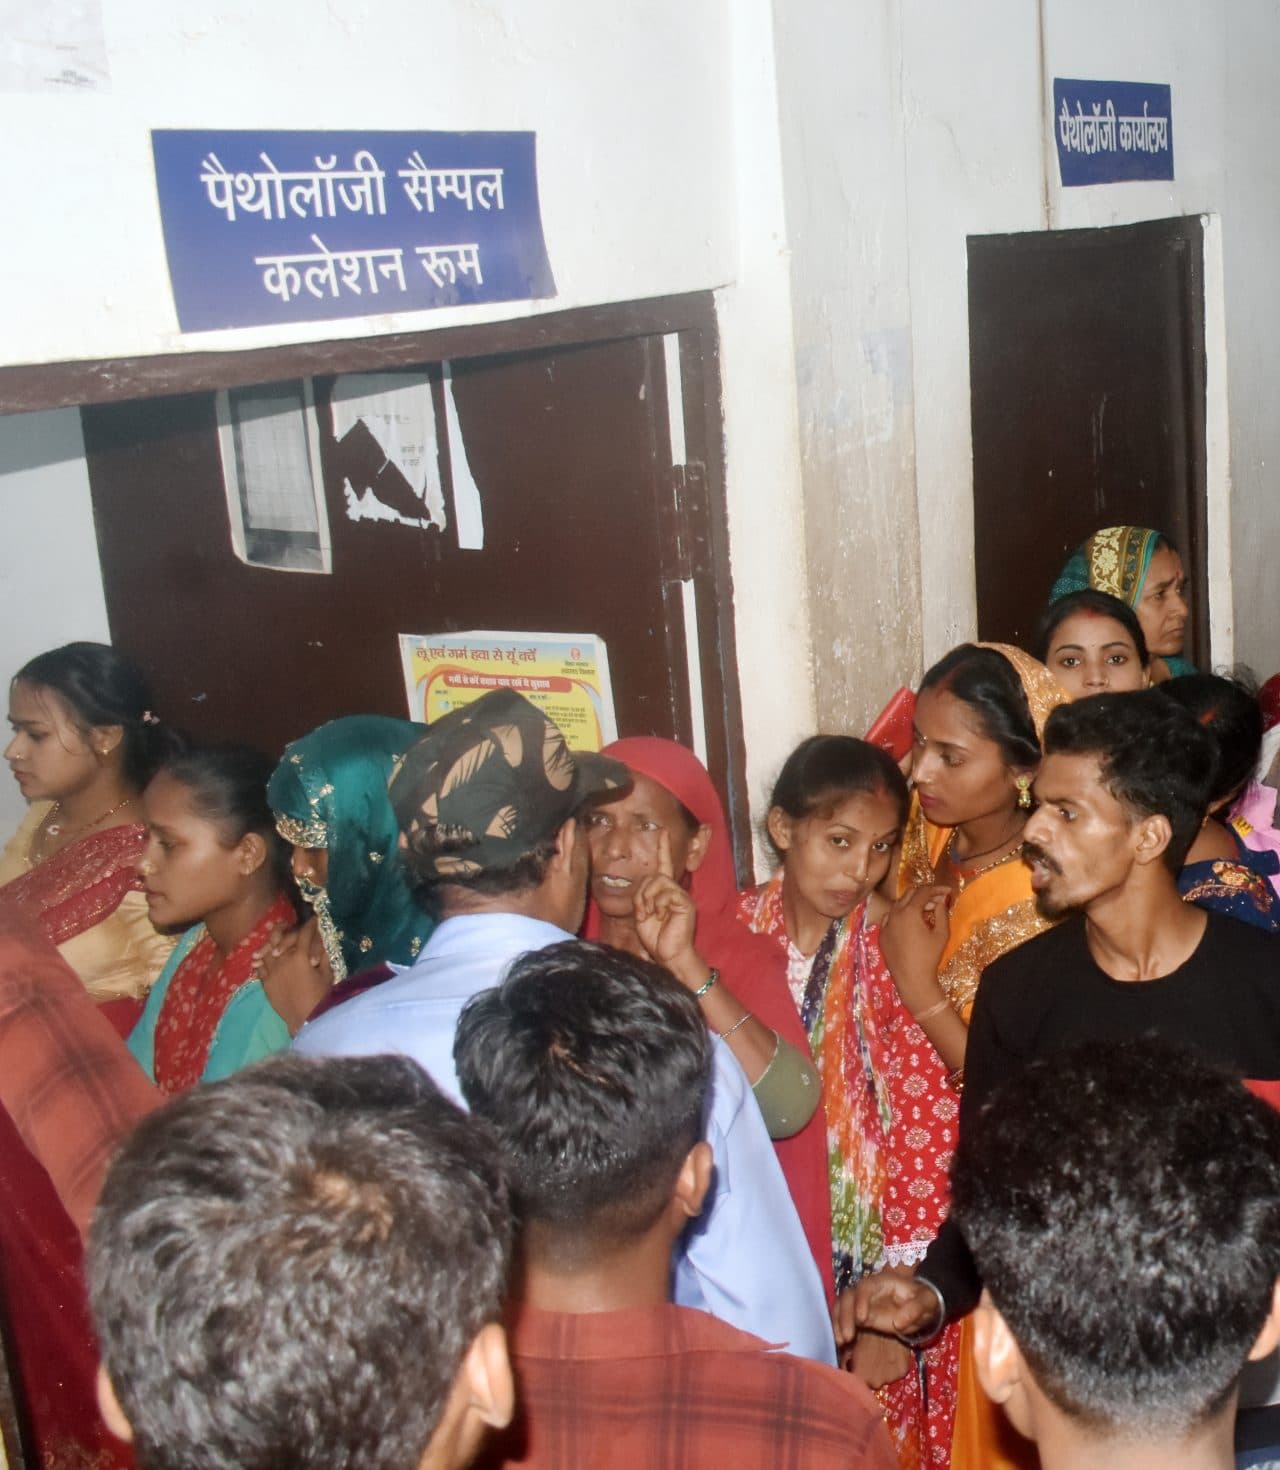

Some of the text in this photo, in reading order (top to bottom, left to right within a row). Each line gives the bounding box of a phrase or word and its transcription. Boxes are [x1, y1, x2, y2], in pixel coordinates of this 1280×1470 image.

[1058, 97, 1168, 155] पैथोलॉजी कार्यालय
[200, 150, 505, 222] पैथोलॉजी सैम्पल
[255, 234, 484, 303] कलेशन रूम
[416, 646, 430, 662] लू
[430, 645, 446, 660] एवं
[447, 645, 468, 660] गर्म
[471, 648, 489, 661] हवा
[492, 647, 503, 661] से
